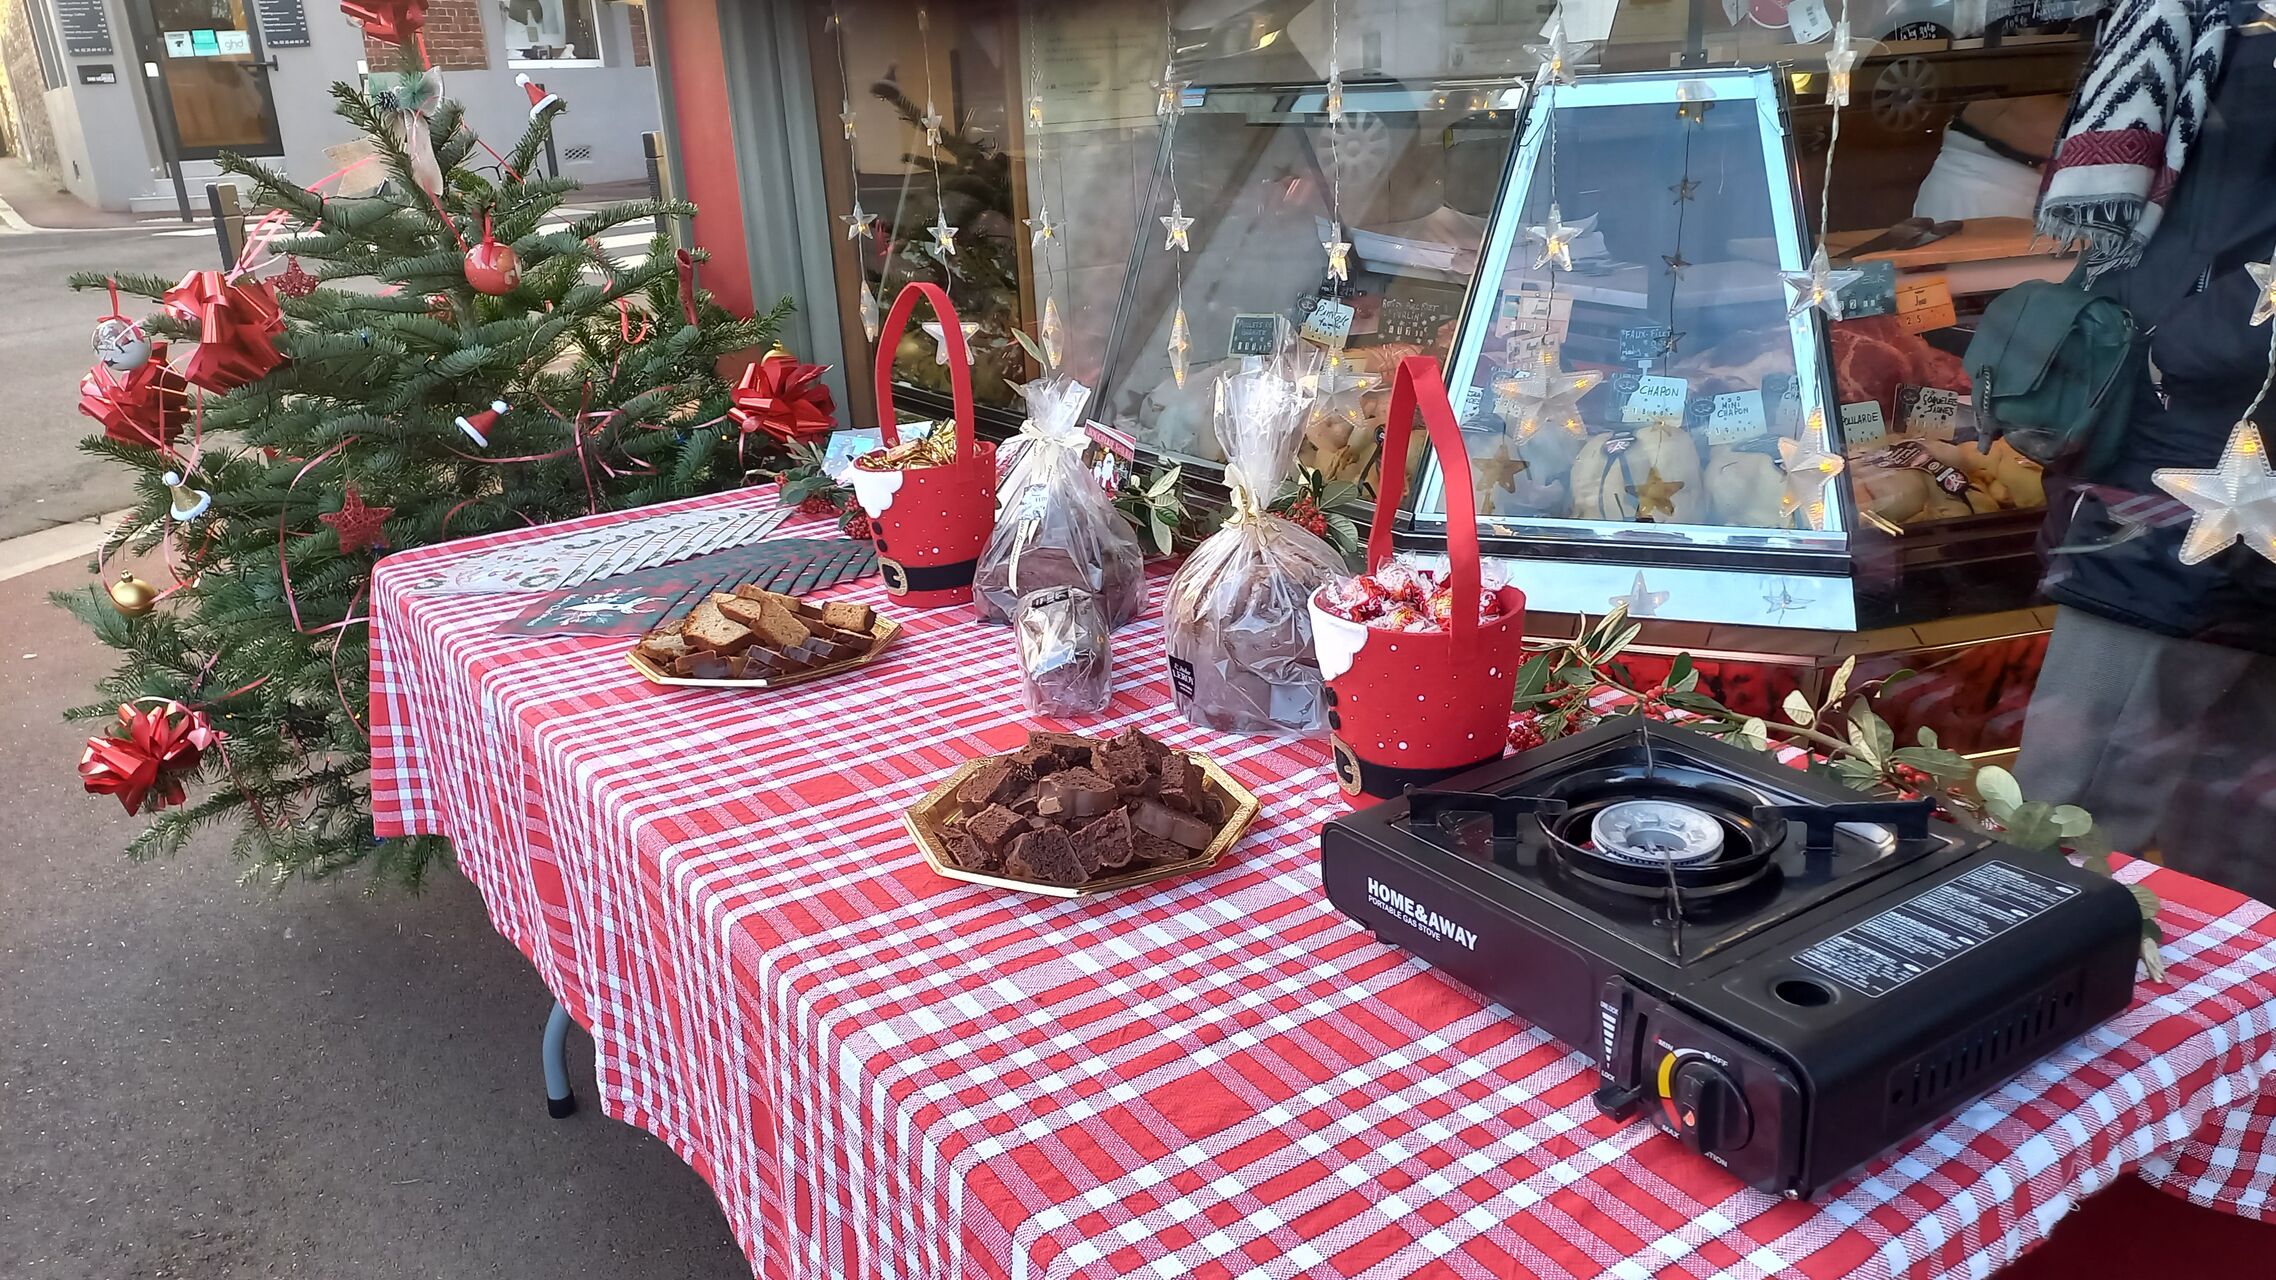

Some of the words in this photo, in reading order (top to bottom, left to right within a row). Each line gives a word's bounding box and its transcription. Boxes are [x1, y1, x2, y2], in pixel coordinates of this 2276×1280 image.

[1640, 385, 1679, 397] CHAPON
[1717, 407, 1749, 418] CHAPON
[1367, 877, 1478, 951] HOME&AWAY
[1368, 895, 1402, 920] PORTABLE
[1403, 915, 1417, 928] GAS
[1418, 922, 1441, 942] STOVE
[1711, 1055, 1729, 1067] OFF
[1601, 1070, 1615, 1083] LOCK
[1662, 1124, 1680, 1140] MAX
